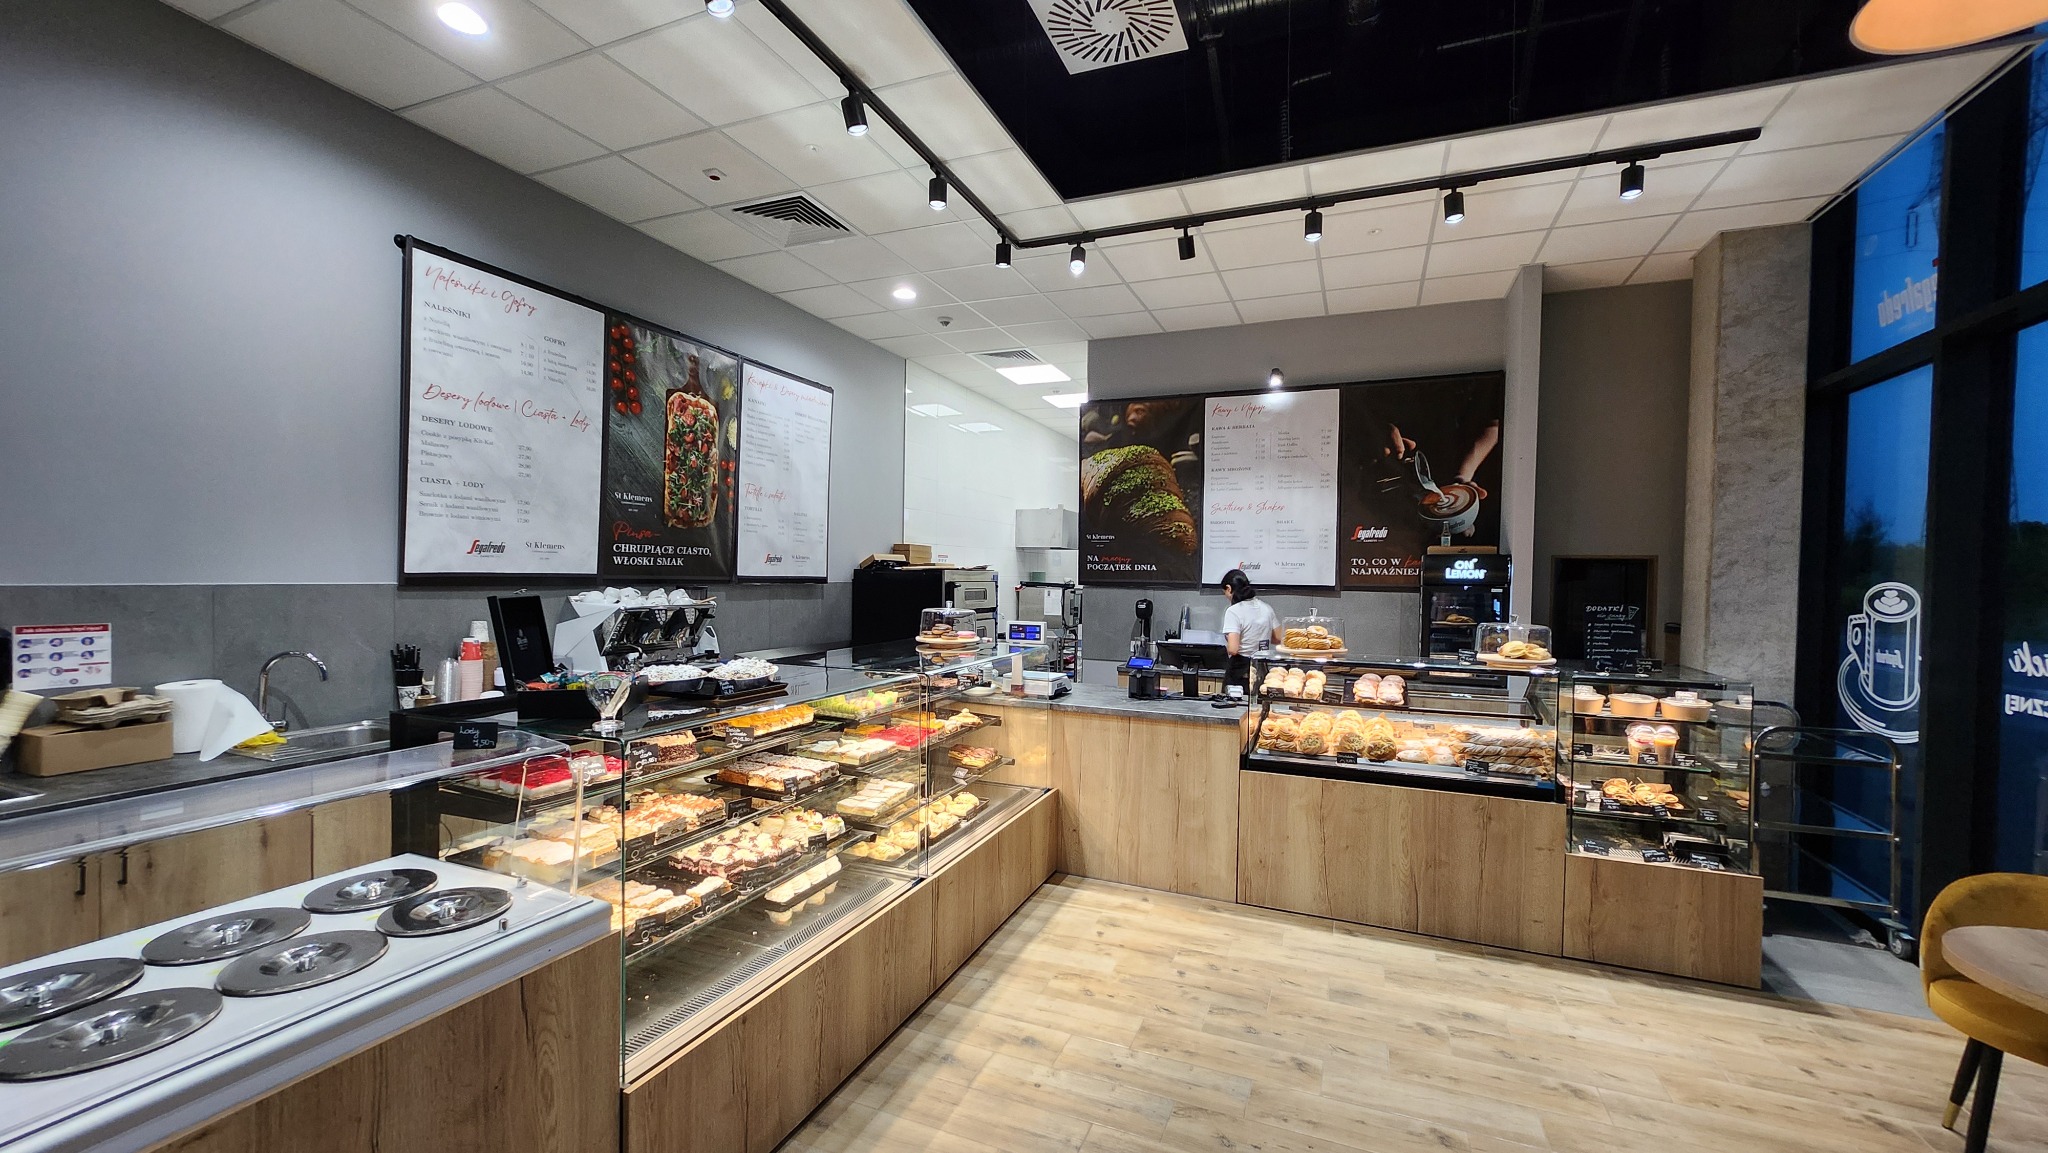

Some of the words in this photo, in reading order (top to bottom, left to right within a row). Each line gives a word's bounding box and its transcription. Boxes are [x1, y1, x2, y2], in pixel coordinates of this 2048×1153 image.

[502, 290, 538, 316] Gofry
[544, 336, 567, 346] GOFRY
[423, 384, 472, 410] Desery
[474, 392, 510, 412] lodowe
[522, 400, 559, 425] Ciasta
[570, 411, 591, 432] Lody
[422, 415, 456, 427] DESERY
[459, 421, 493, 432] LODOWE
[420, 476, 452, 486] CIASTA
[463, 481, 485, 489] LODY
[615, 492, 622, 500] St
[623, 493, 653, 503] Klemens
[1351, 526, 1389, 540] Segafredo
[467, 540, 506, 555] Segafredo
[534, 542, 565, 550] Klemens
[613, 543, 674, 555] CHRUPIĄCE
[677, 546, 712, 557] CIASTO,
[613, 556, 654, 566] WŁOSKI
[656, 557, 684, 566] SMAK
[1351, 558, 1368, 566] TO,
[1372, 558, 1387, 566] CO
[1390, 558, 1402, 566] W
[1454, 560, 1476, 570] ON
[1087, 564, 1132, 572] POCZĄTEK
[1446, 568, 1485, 579] LEMON
[460, 726, 480, 739] Lody
